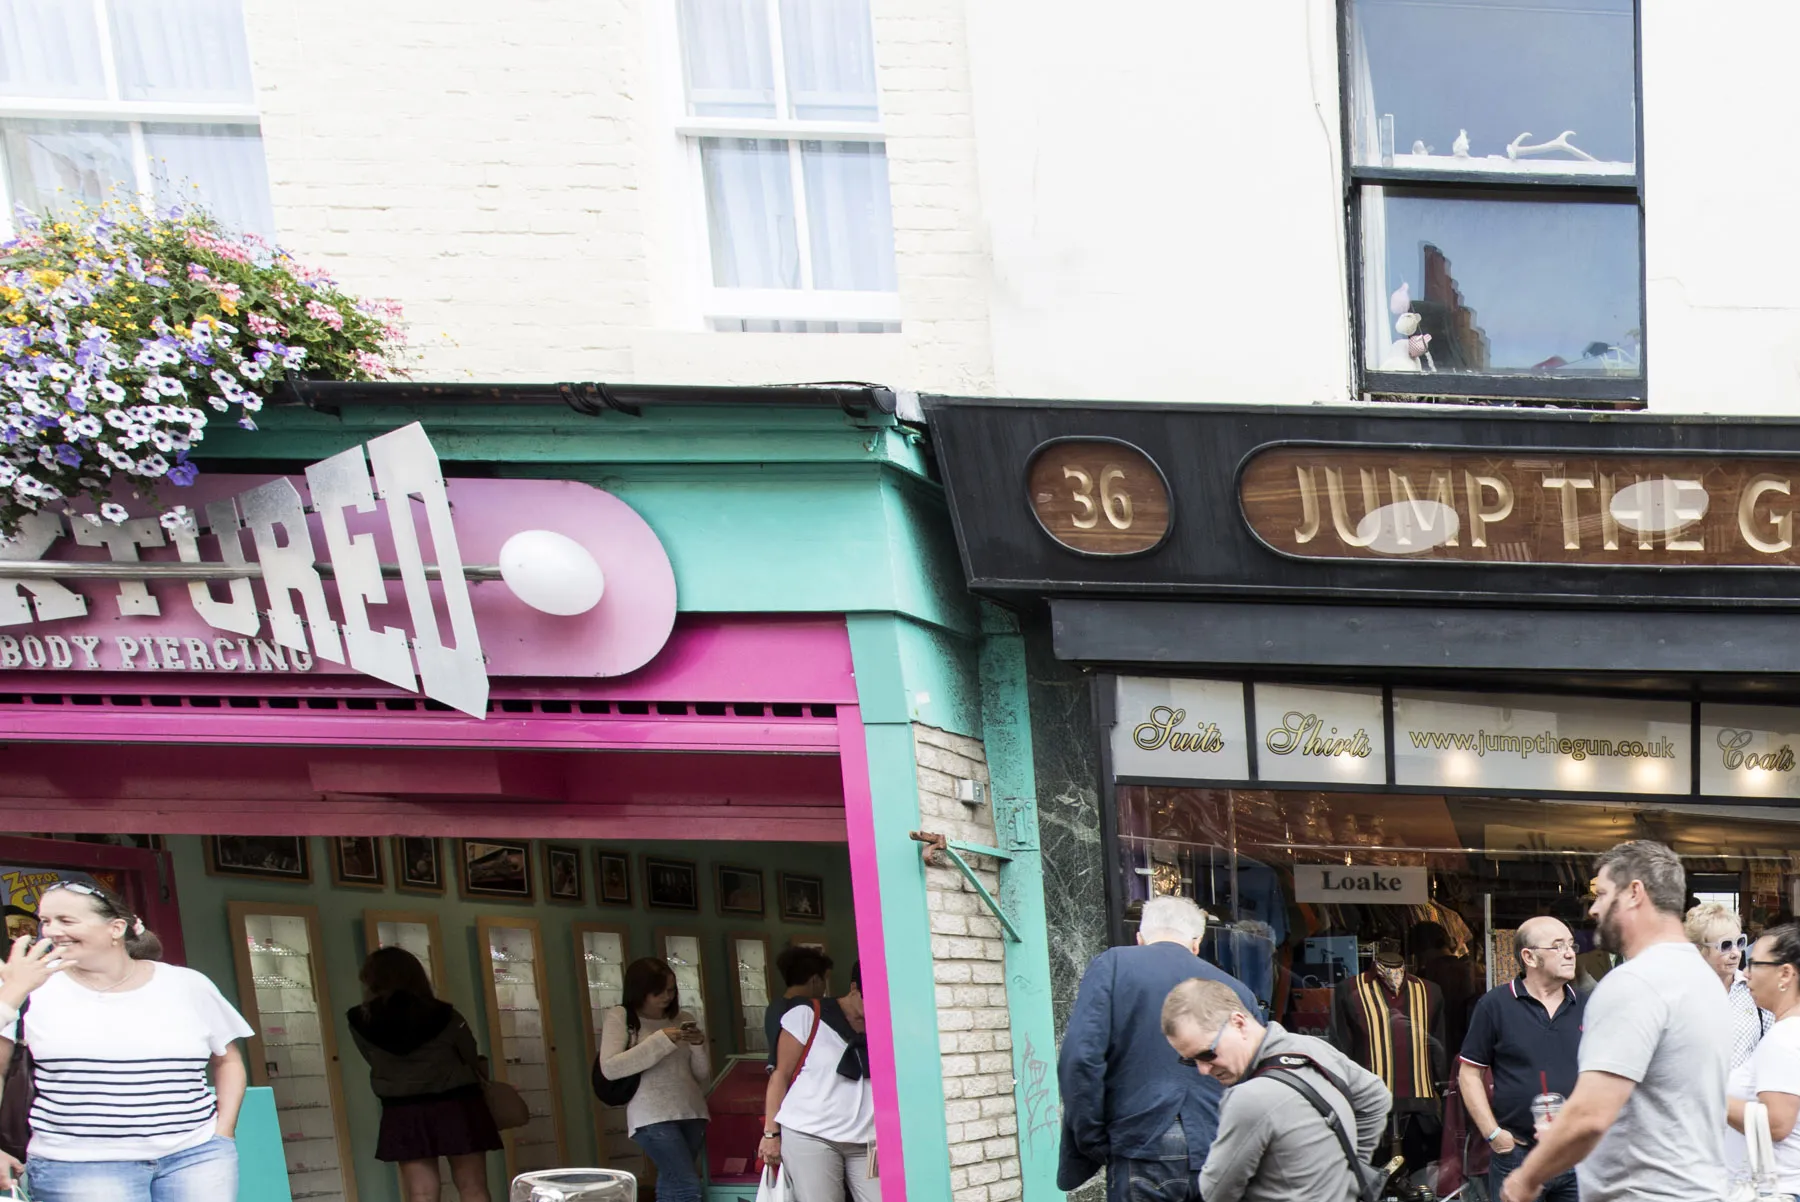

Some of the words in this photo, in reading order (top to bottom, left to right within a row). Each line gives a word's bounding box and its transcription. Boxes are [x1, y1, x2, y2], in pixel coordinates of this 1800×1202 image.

[1062, 464, 1135, 530] 36
[1294, 466, 1515, 549] JUMP
[1542, 473, 1704, 552] THE
[0, 634, 101, 669] BODY
[115, 636, 314, 672] PIERCING
[1132, 706, 1226, 754] Suits
[1266, 711, 1372, 760] Shirts
[1409, 727, 1676, 761] www.jumpthegun.co.uk
[1717, 728, 1797, 773] Coats
[2, 871, 59, 893] ZIPPOS
[1321, 870, 1402, 892] Loake
